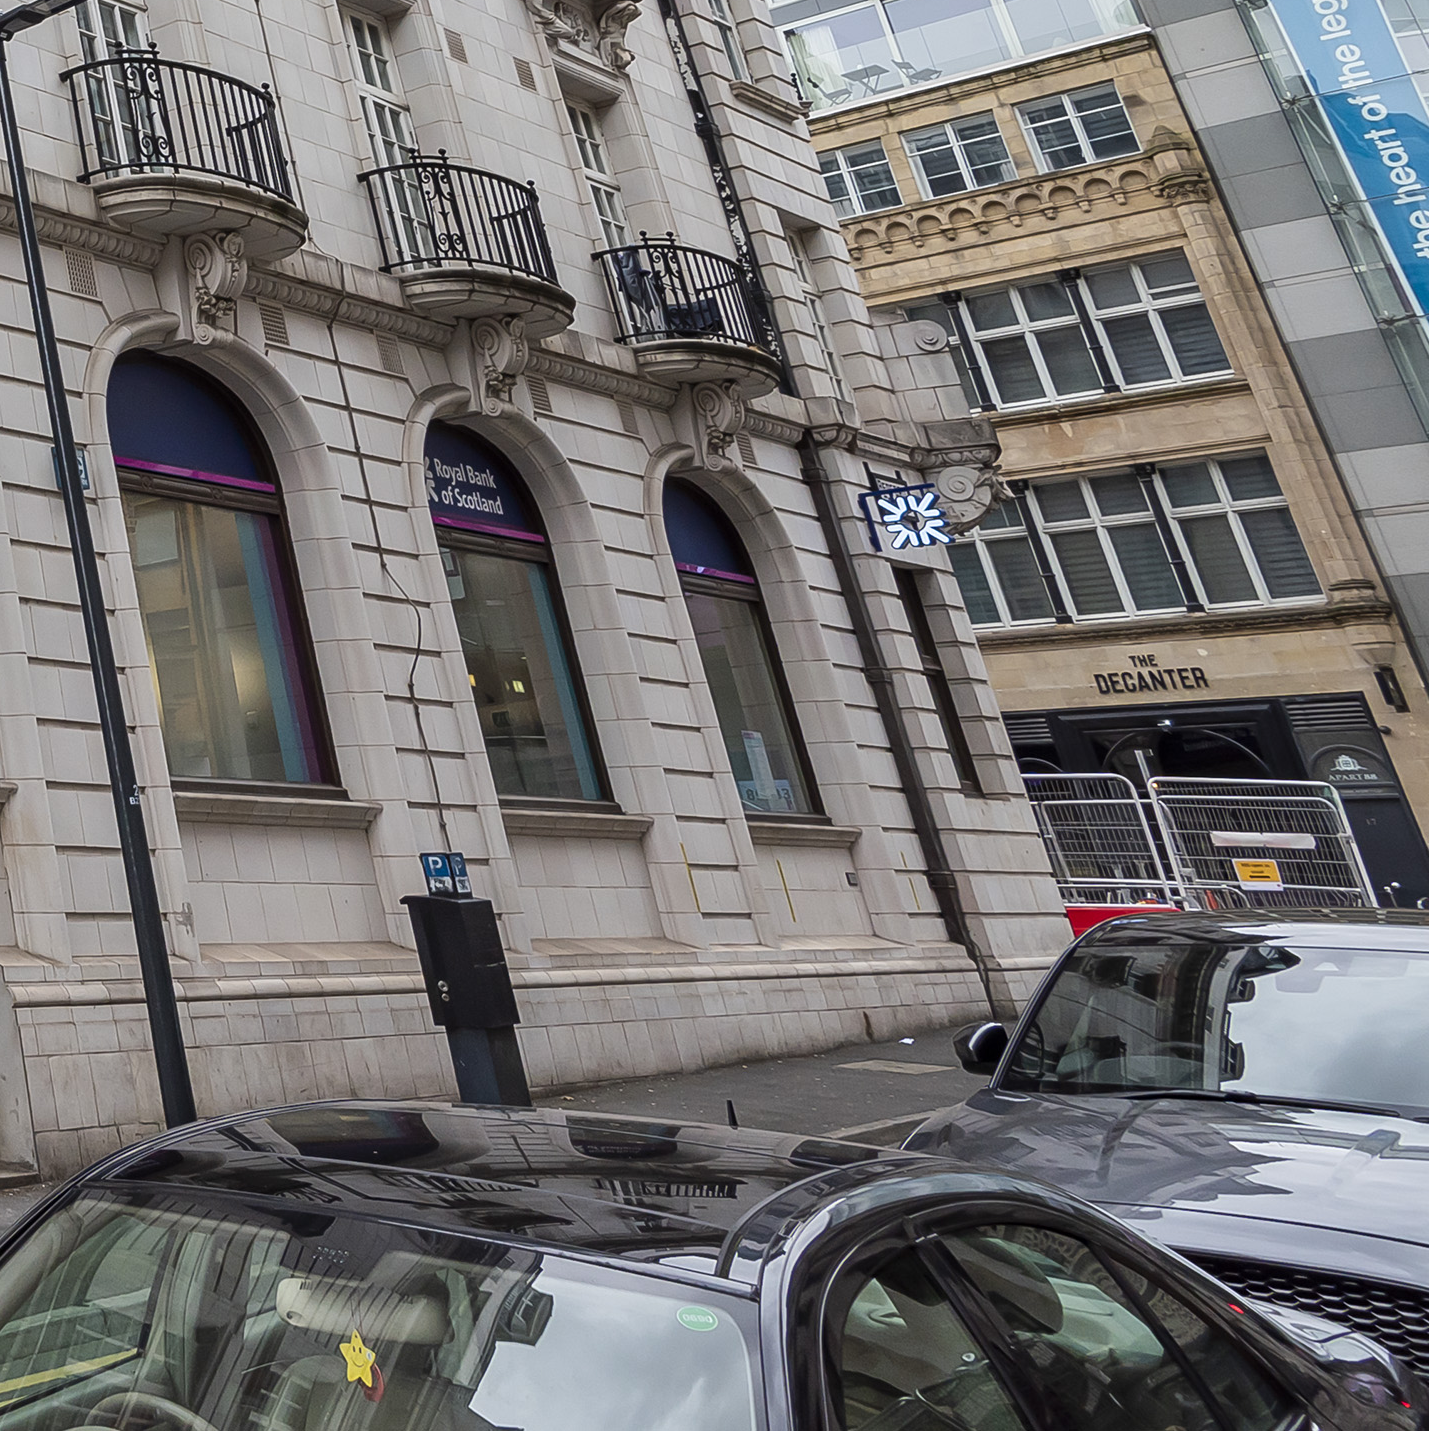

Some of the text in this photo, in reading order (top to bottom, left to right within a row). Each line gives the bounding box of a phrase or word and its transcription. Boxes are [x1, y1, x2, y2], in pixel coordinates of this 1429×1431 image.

[1335, 44, 1373, 90] the
[1347, 94, 1388, 122] of
[1363, 128, 1427, 205] heart
[433, 458, 497, 489] Royal Bank
[441, 486, 504, 515] of Scotland
[1128, 654, 1158, 668] THE
[1093, 667, 1210, 695] DECANTER
[428, 856, 442, 875] P
